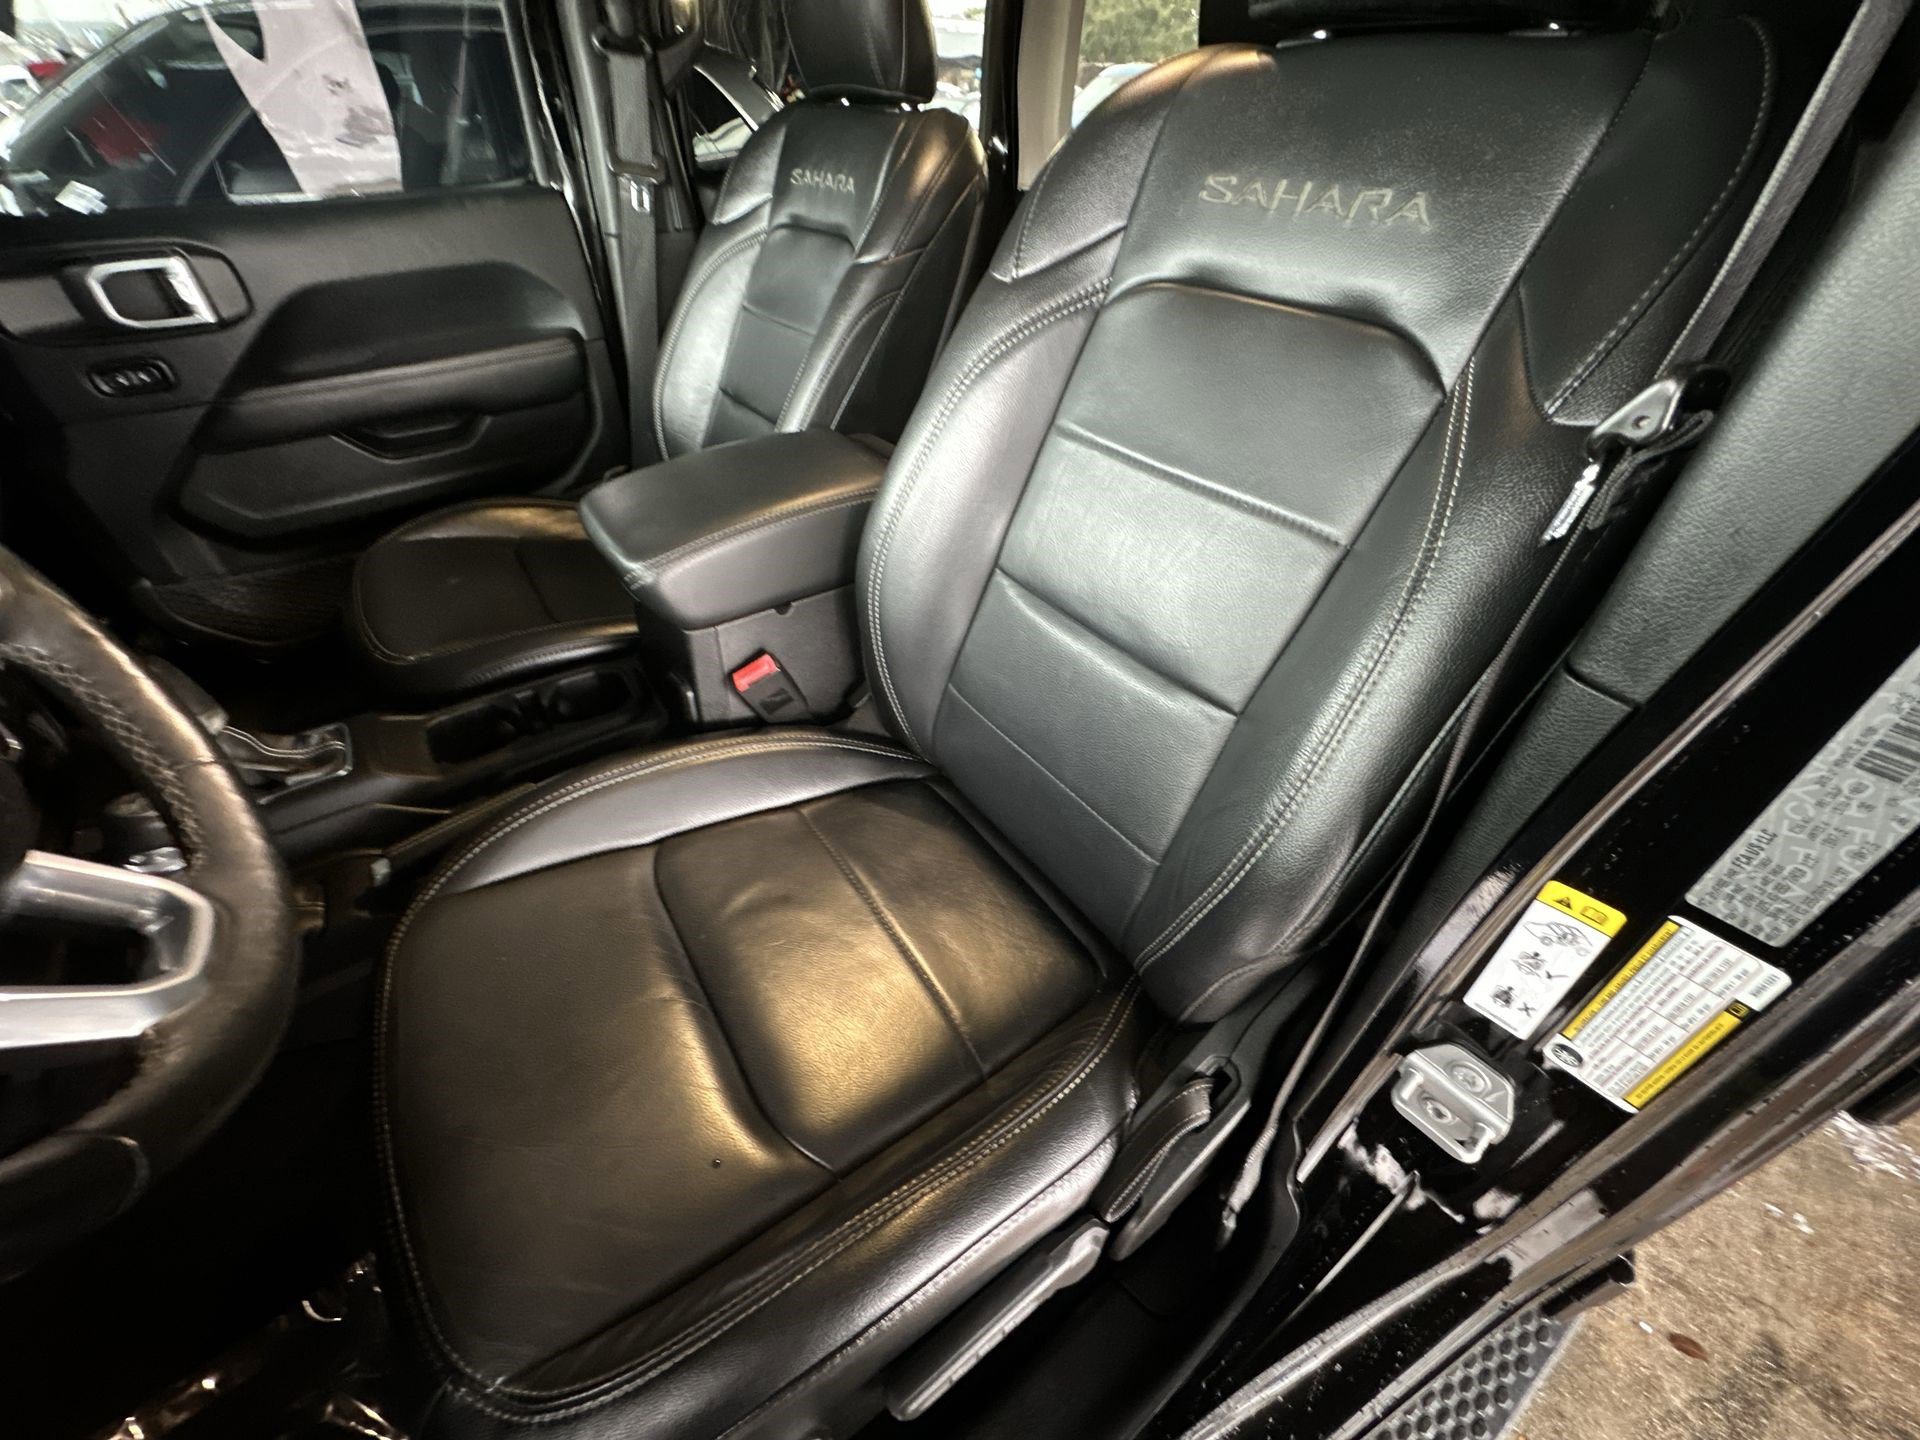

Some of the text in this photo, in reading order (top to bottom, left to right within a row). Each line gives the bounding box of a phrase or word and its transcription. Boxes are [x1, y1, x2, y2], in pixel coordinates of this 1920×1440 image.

[790, 168, 855, 194] SAHARA
[1199, 175, 1431, 231] SAHARA
[1754, 828, 1778, 846] LLC
[1744, 842, 1765, 856] US
[1731, 853, 1754, 870] FCA
